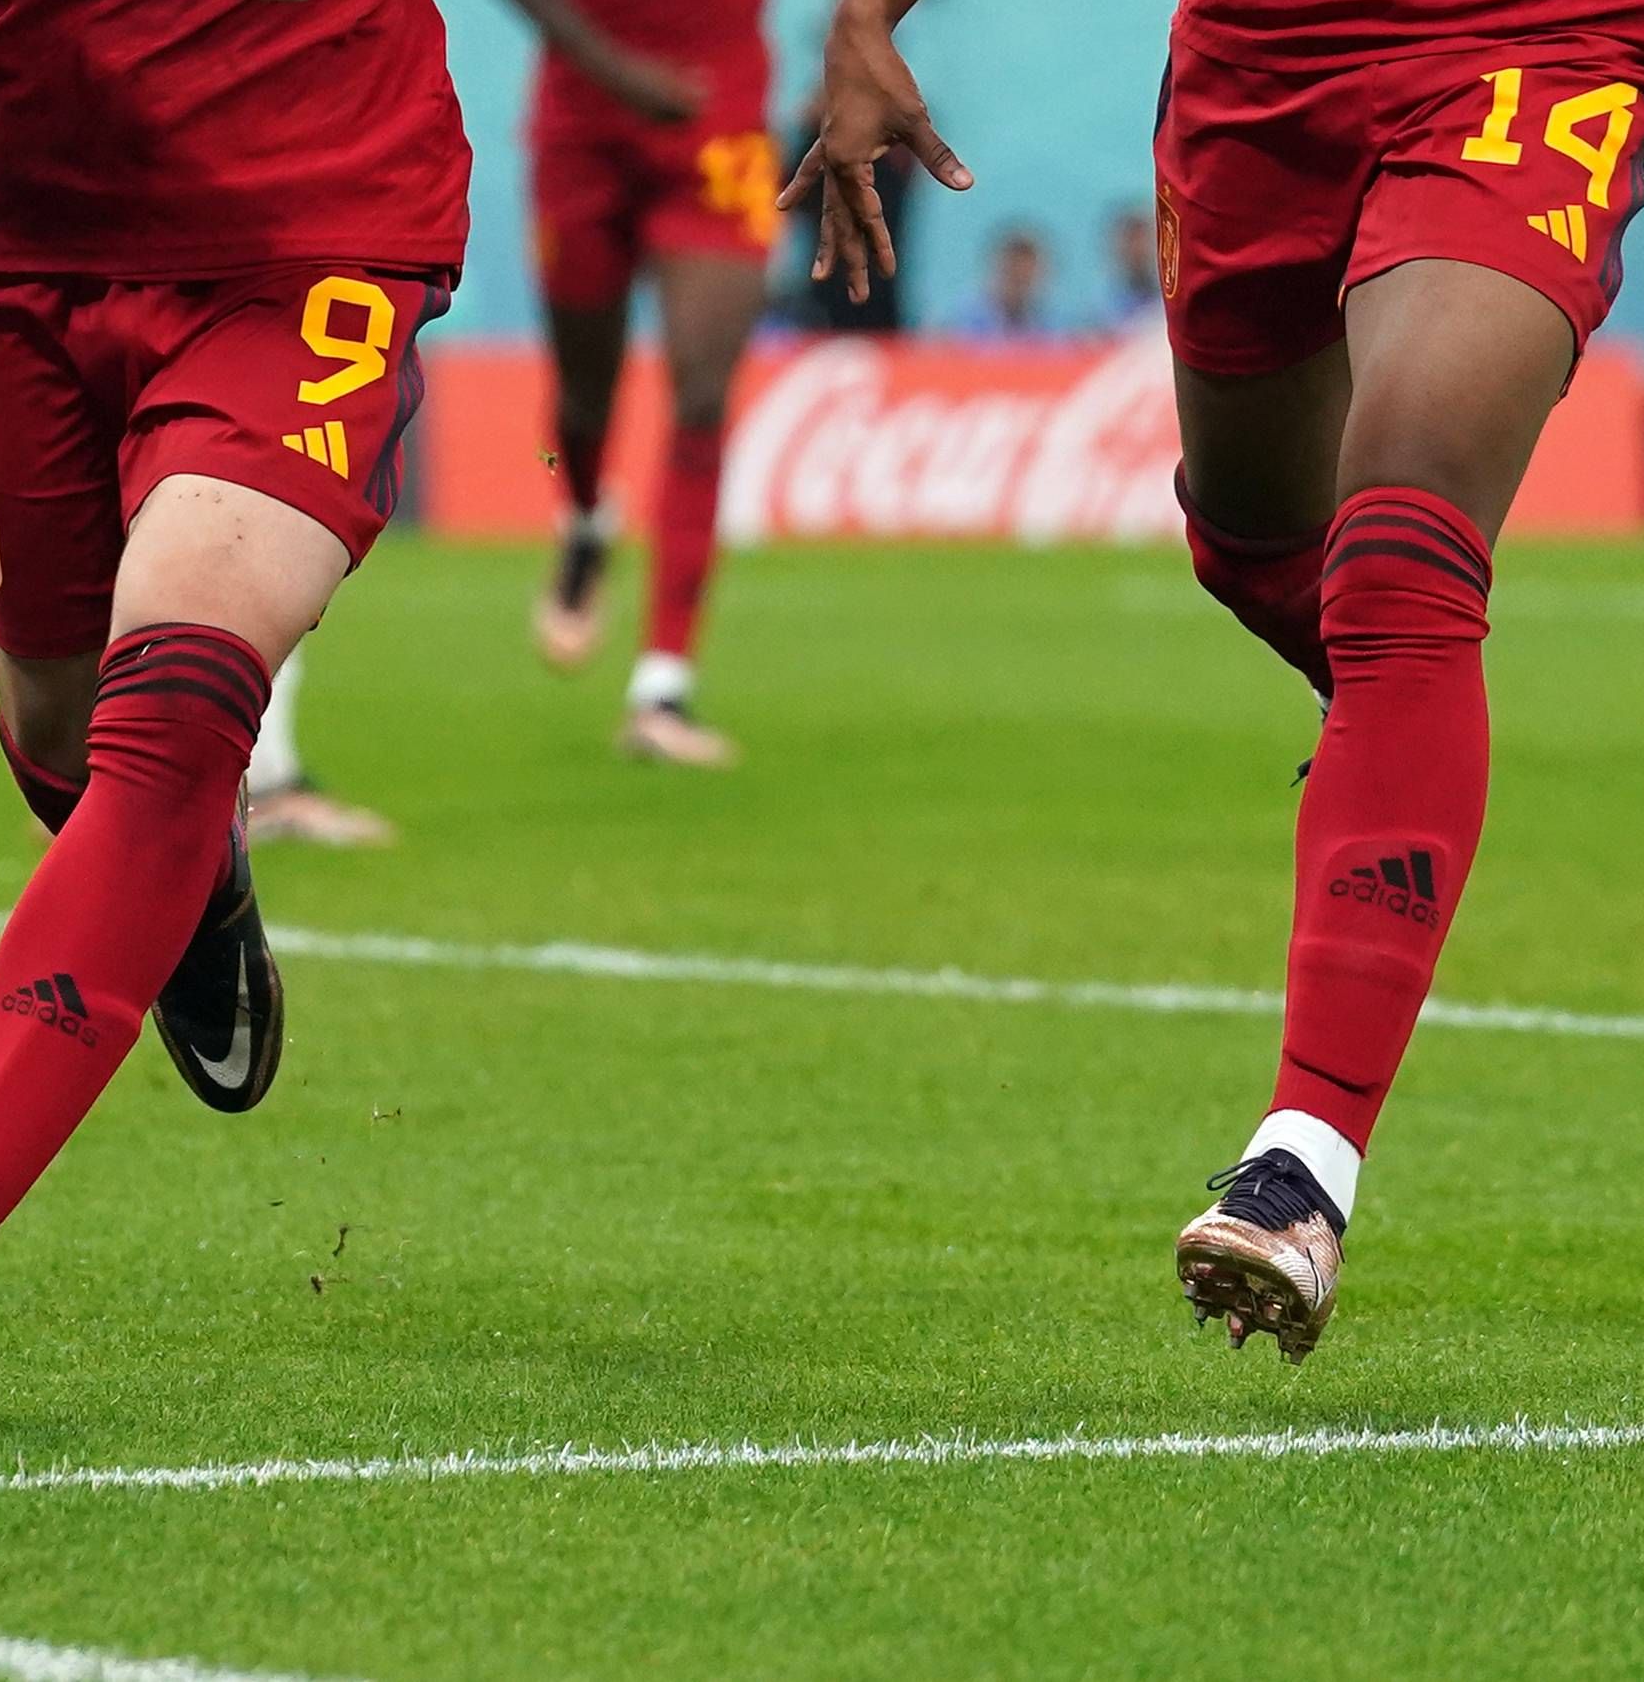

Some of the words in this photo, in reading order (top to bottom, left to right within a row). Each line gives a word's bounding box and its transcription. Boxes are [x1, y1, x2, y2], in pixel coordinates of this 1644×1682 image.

[1460, 67, 1639, 209] 14
[297, 276, 396, 405] 9
[1329, 878, 1441, 932] adidas
[1, 993, 100, 1049] adidas
